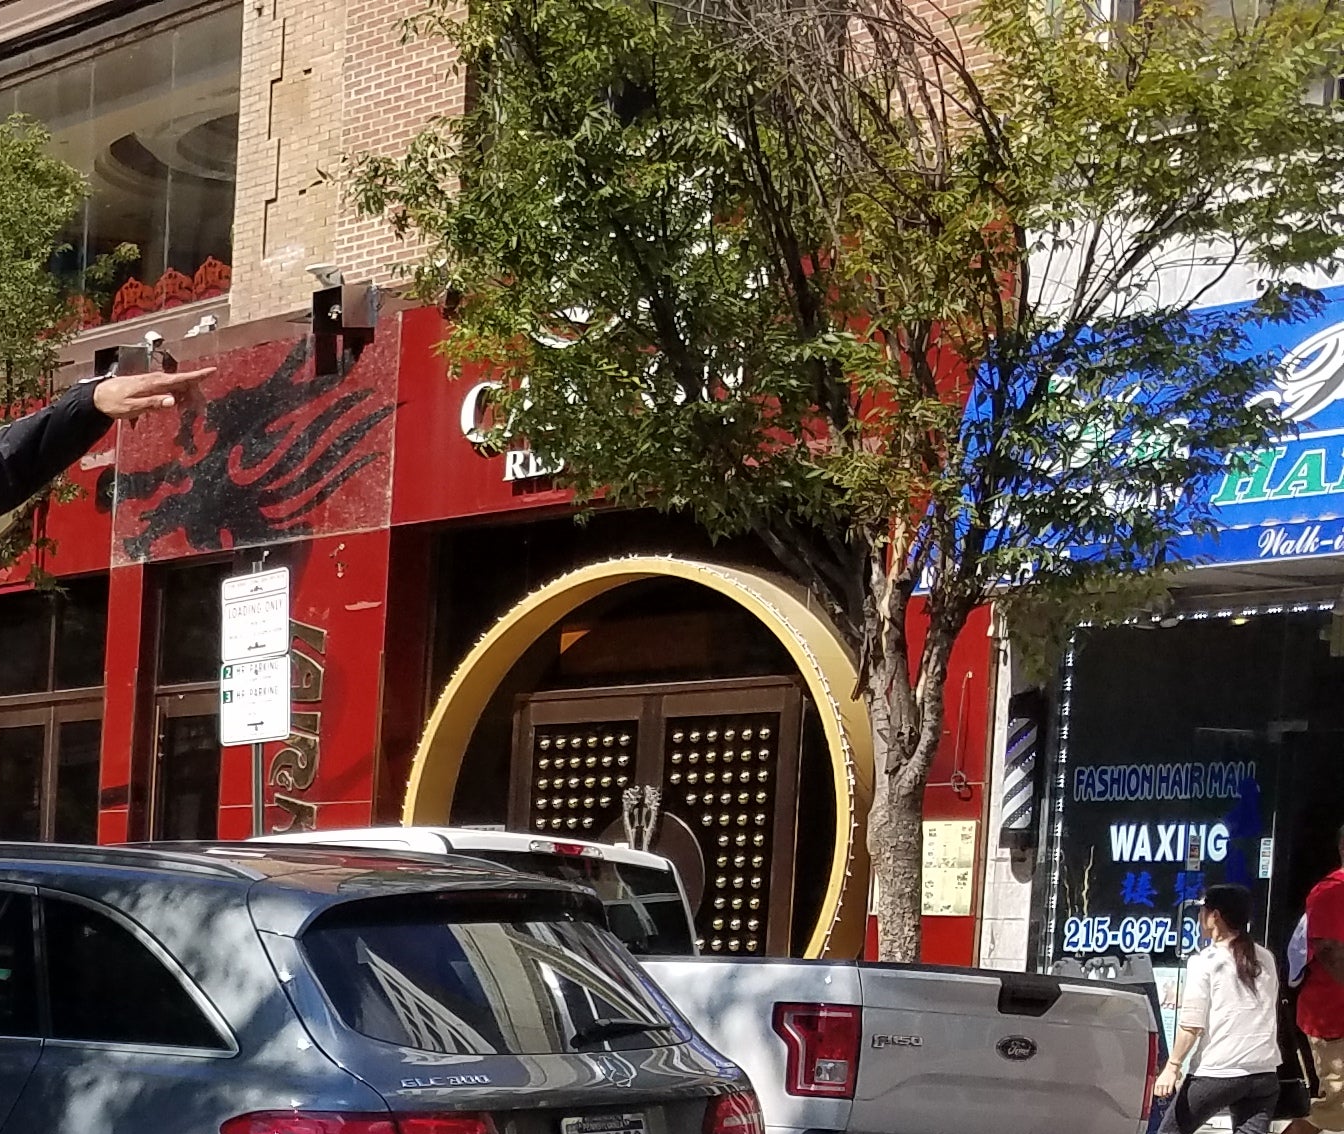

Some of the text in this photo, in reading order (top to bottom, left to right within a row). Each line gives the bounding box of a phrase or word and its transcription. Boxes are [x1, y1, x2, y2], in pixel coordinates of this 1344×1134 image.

[228, 599, 283, 620] LOADING ONLY
[1074, 765, 1154, 801] FASHION
[1156, 762, 1203, 800] HAIR
[1110, 822, 1229, 862] WAXING
[401, 1076, 442, 1088] GLC
